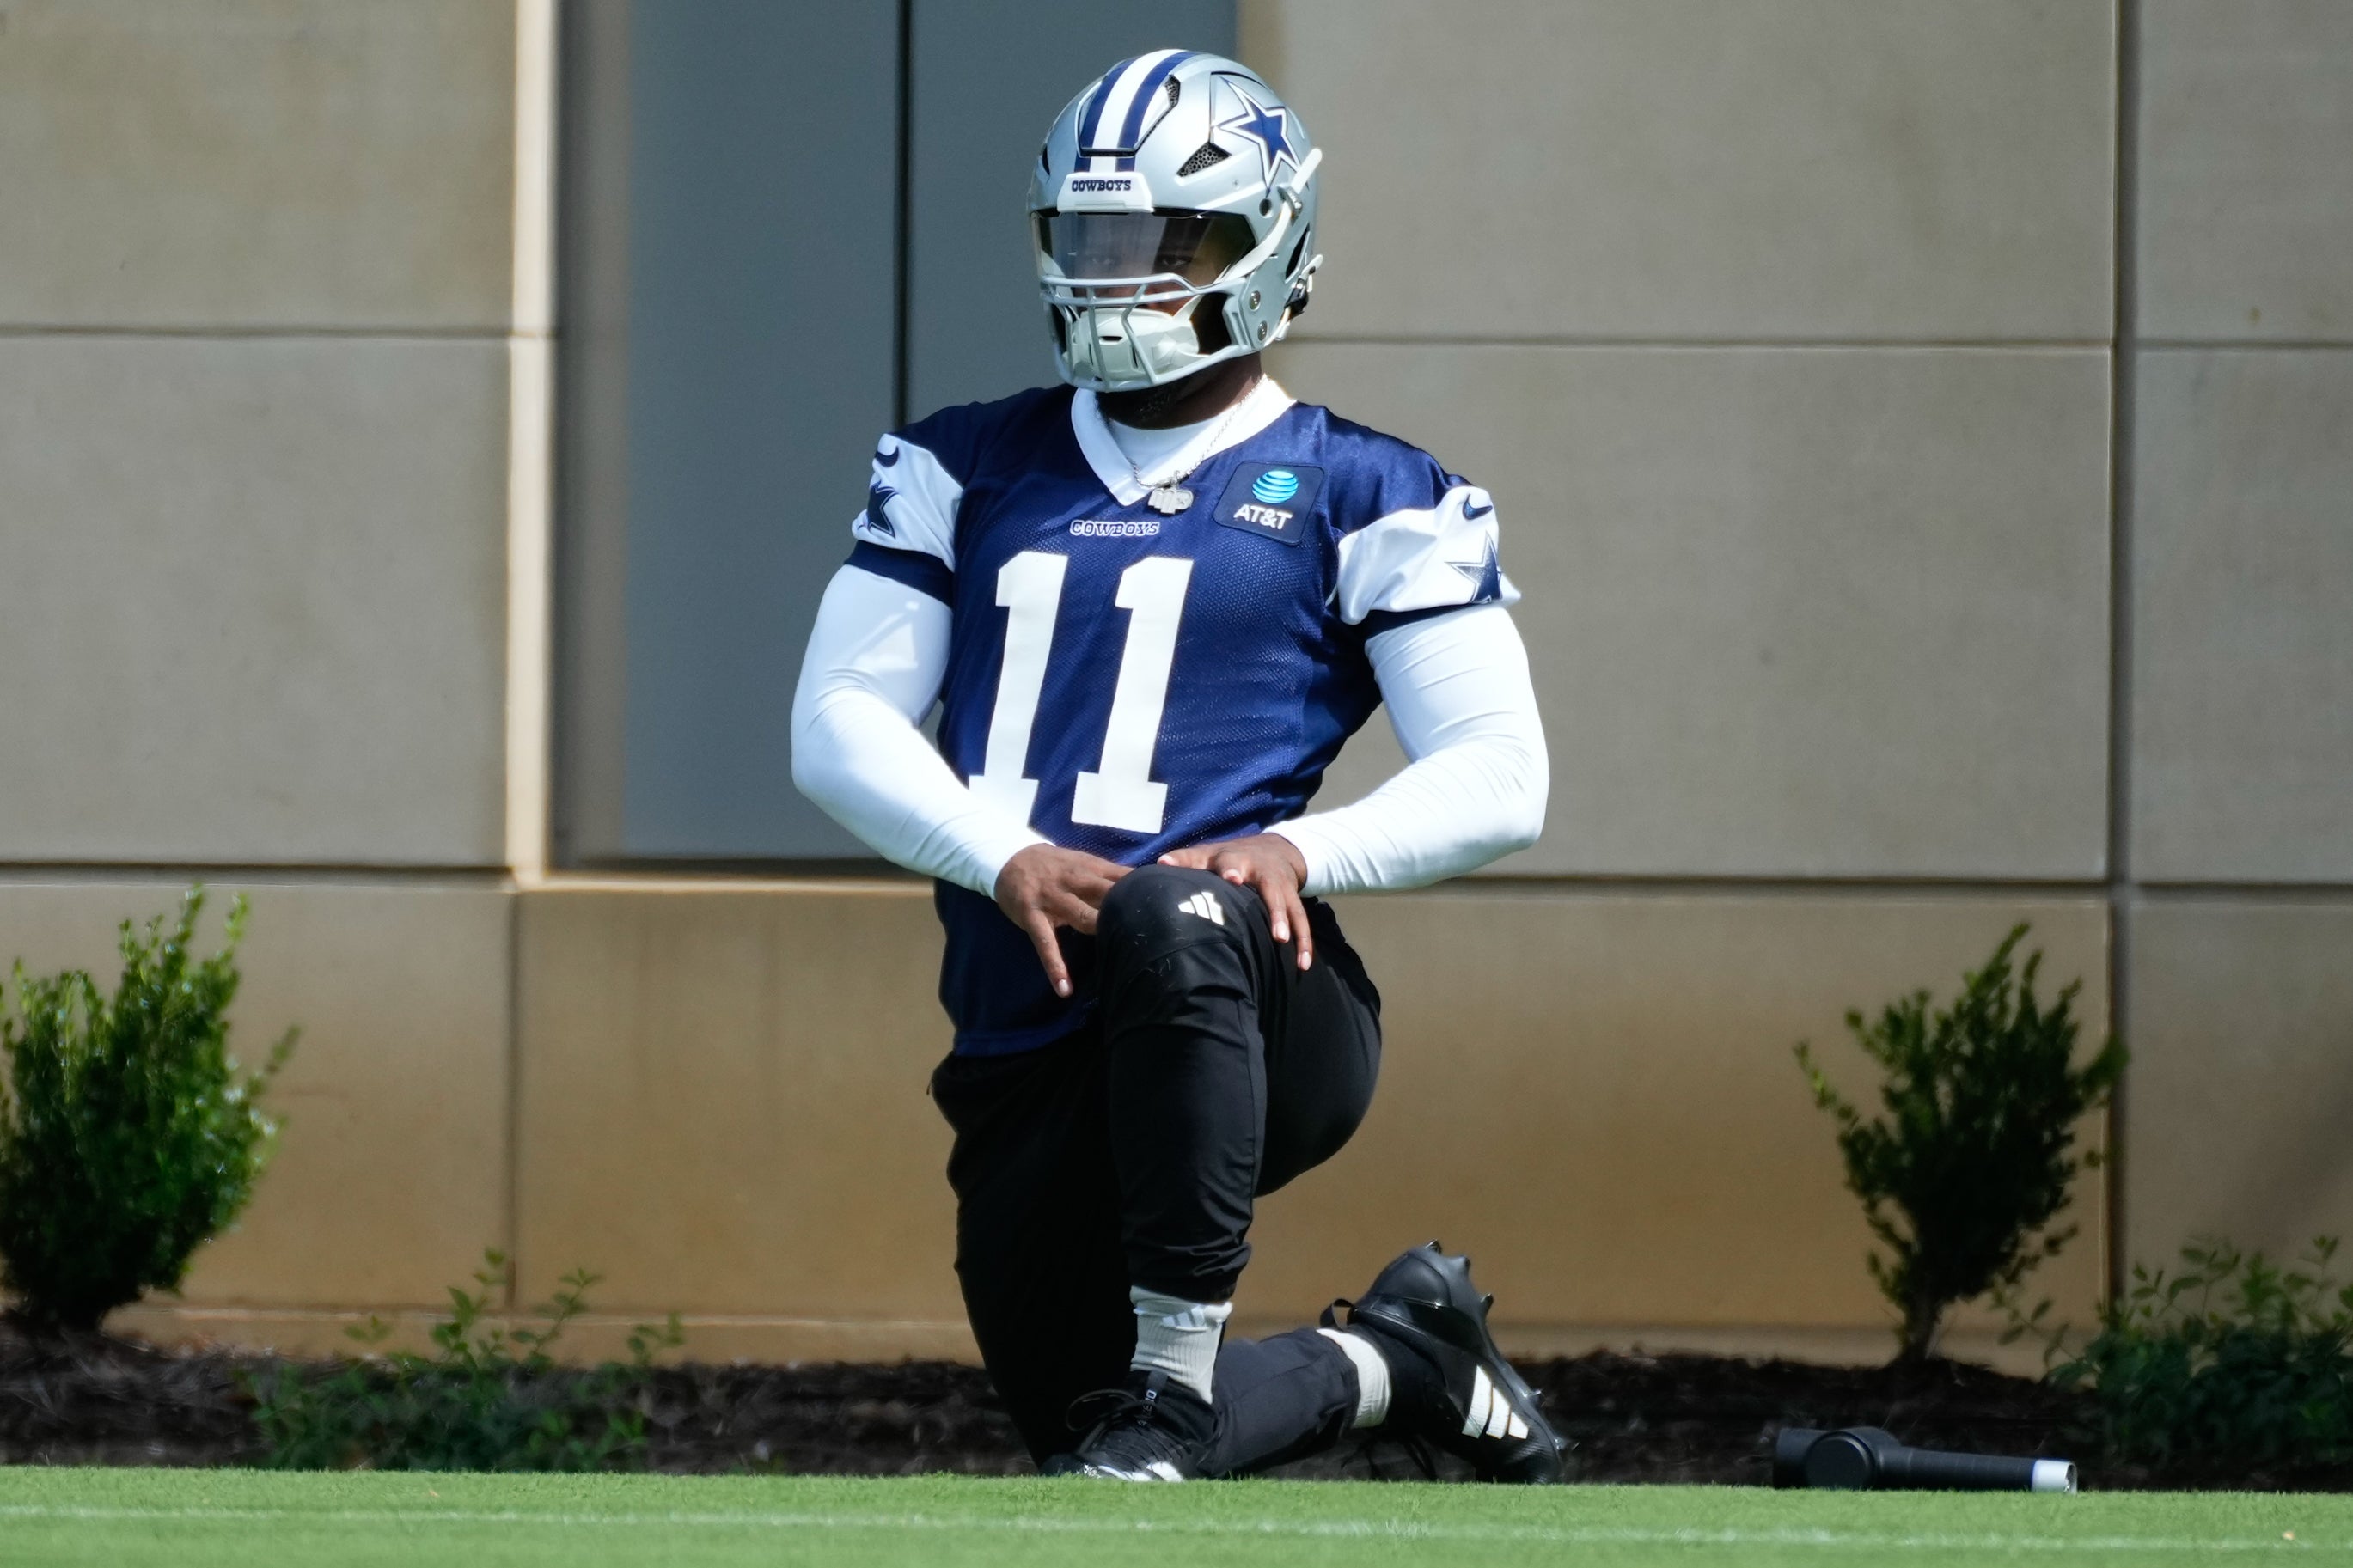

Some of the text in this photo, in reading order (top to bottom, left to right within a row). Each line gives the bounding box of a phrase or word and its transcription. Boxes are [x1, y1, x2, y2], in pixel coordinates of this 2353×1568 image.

[1072, 180, 1131, 192] COWBOYS
[1233, 503, 1293, 530] AT&T
[1069, 519, 1160, 537] COWBOYS
[968, 550, 1194, 834] 11
